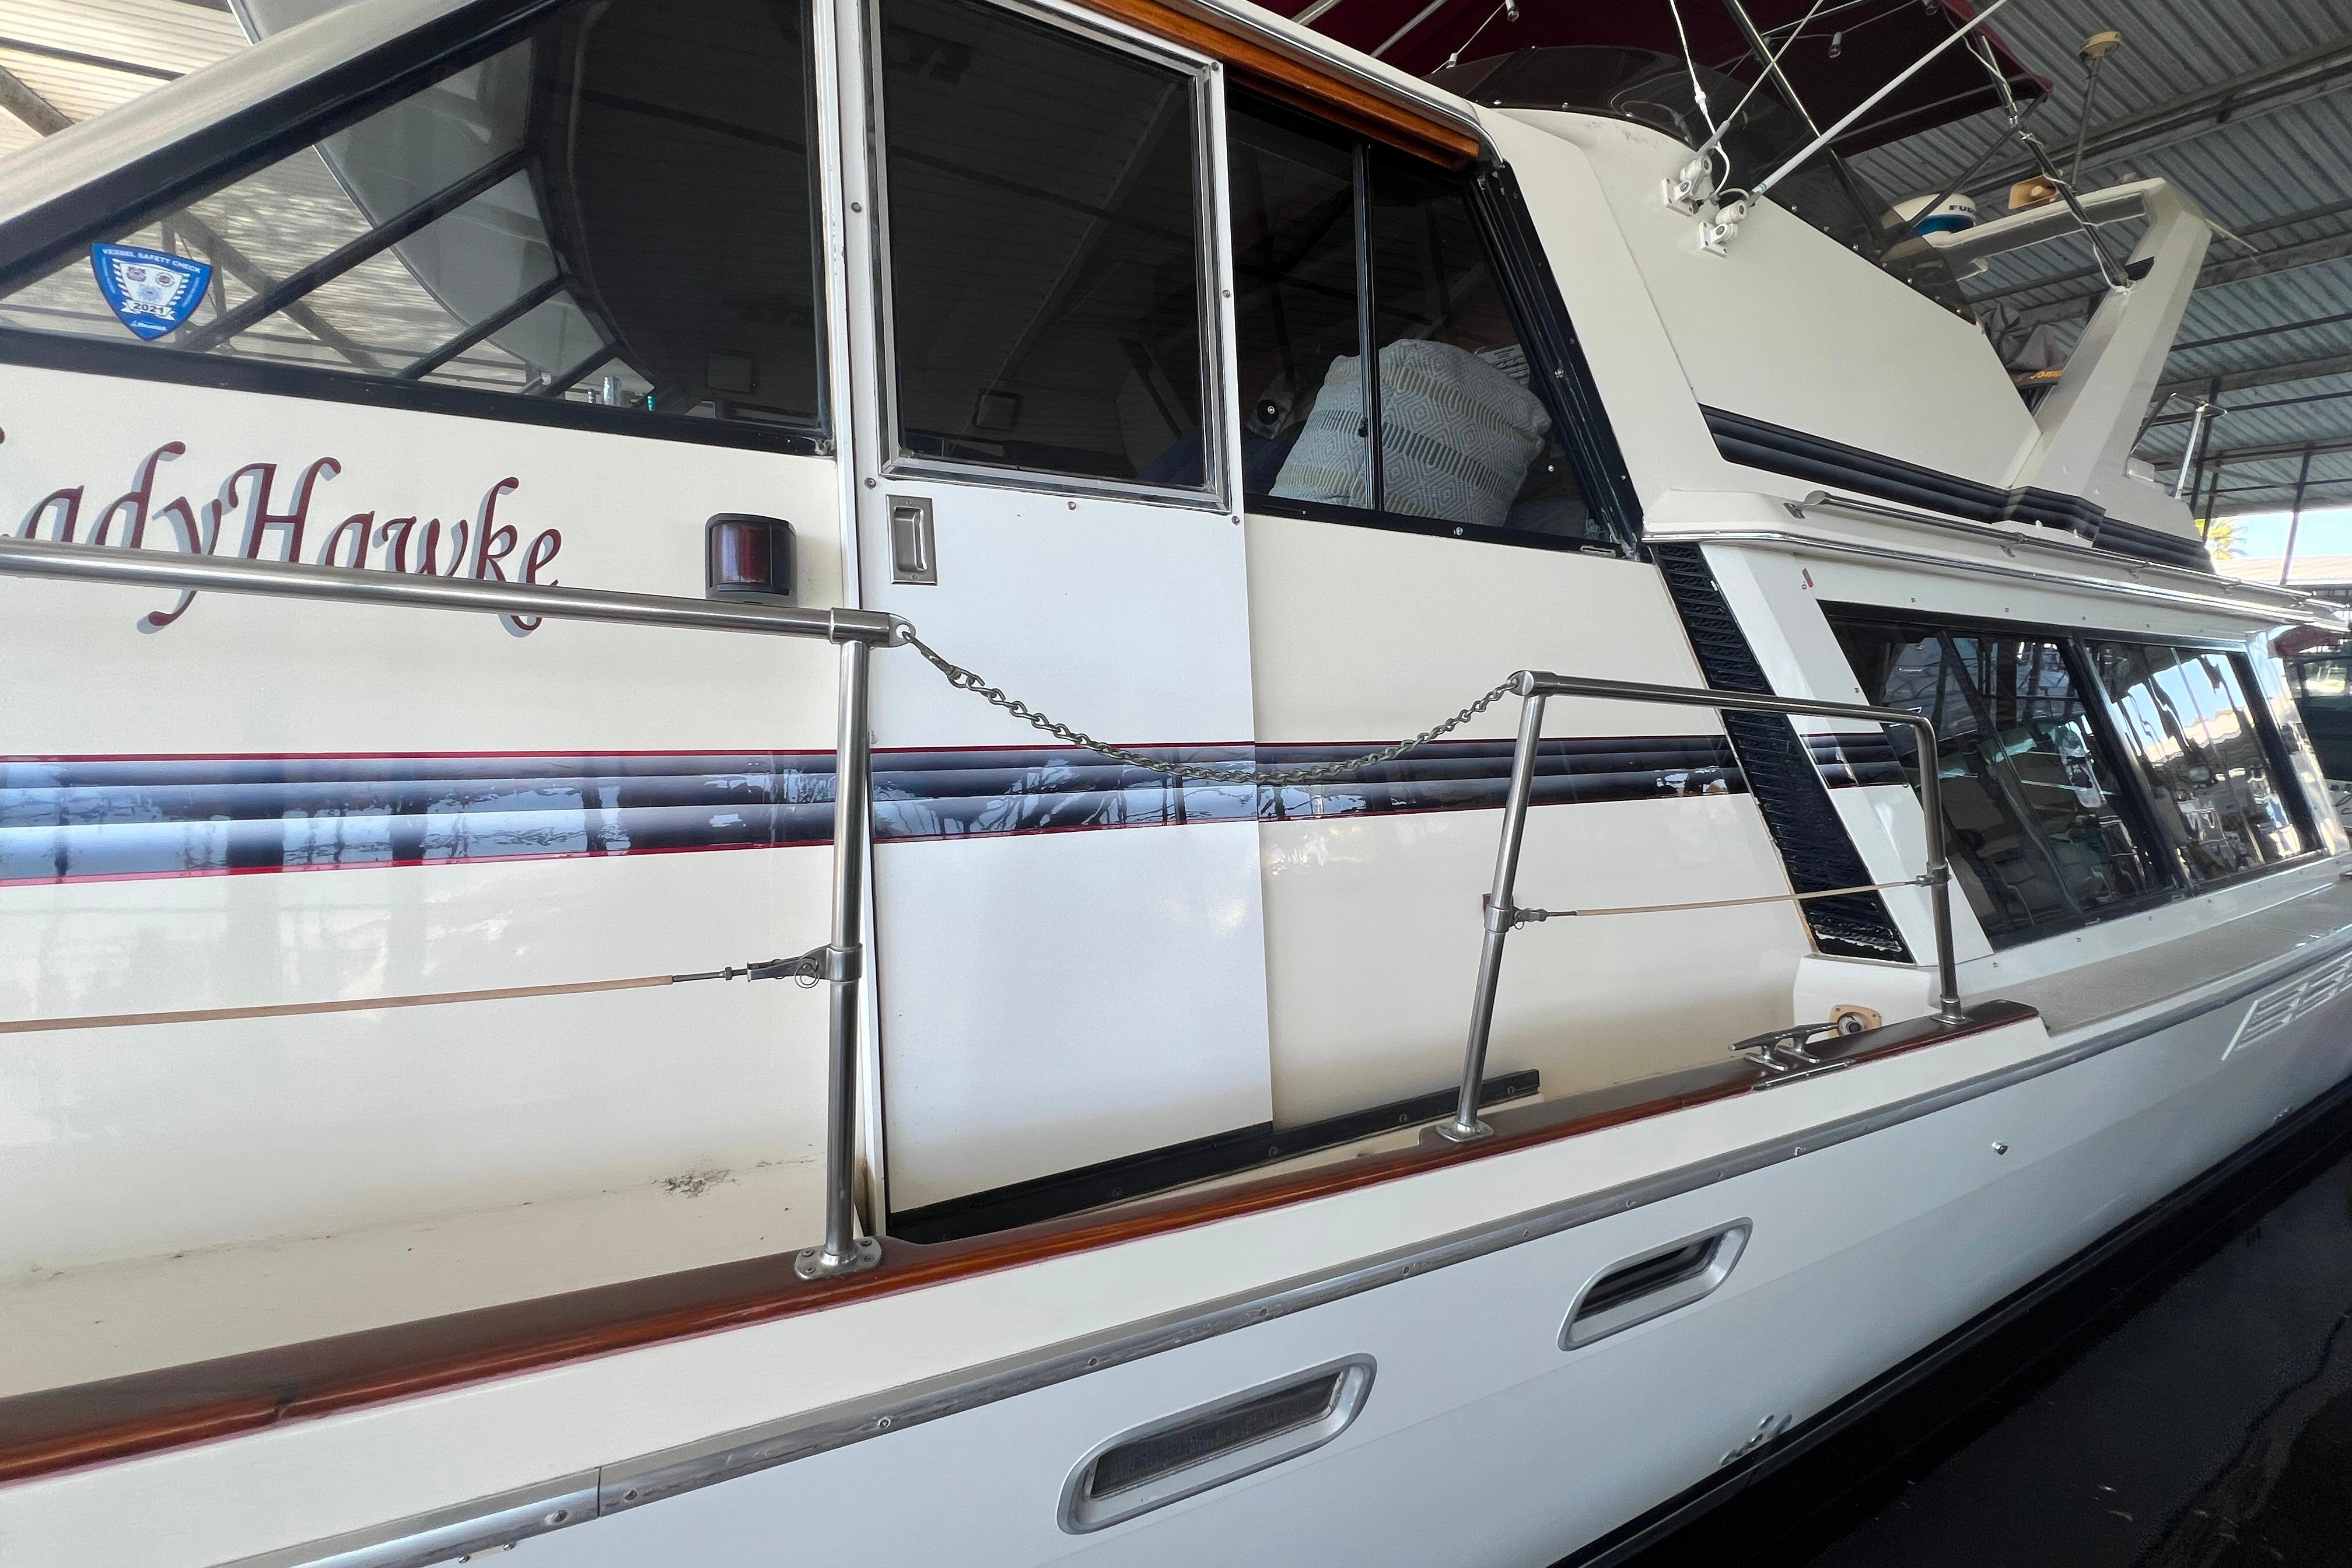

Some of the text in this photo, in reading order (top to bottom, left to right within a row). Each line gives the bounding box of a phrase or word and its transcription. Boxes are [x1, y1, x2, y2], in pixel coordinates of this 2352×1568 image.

[102, 249, 201, 274] VESSEL SAFETY CHECK
[133, 302, 164, 313] 2021
[0, 427, 563, 636] adyHawke
